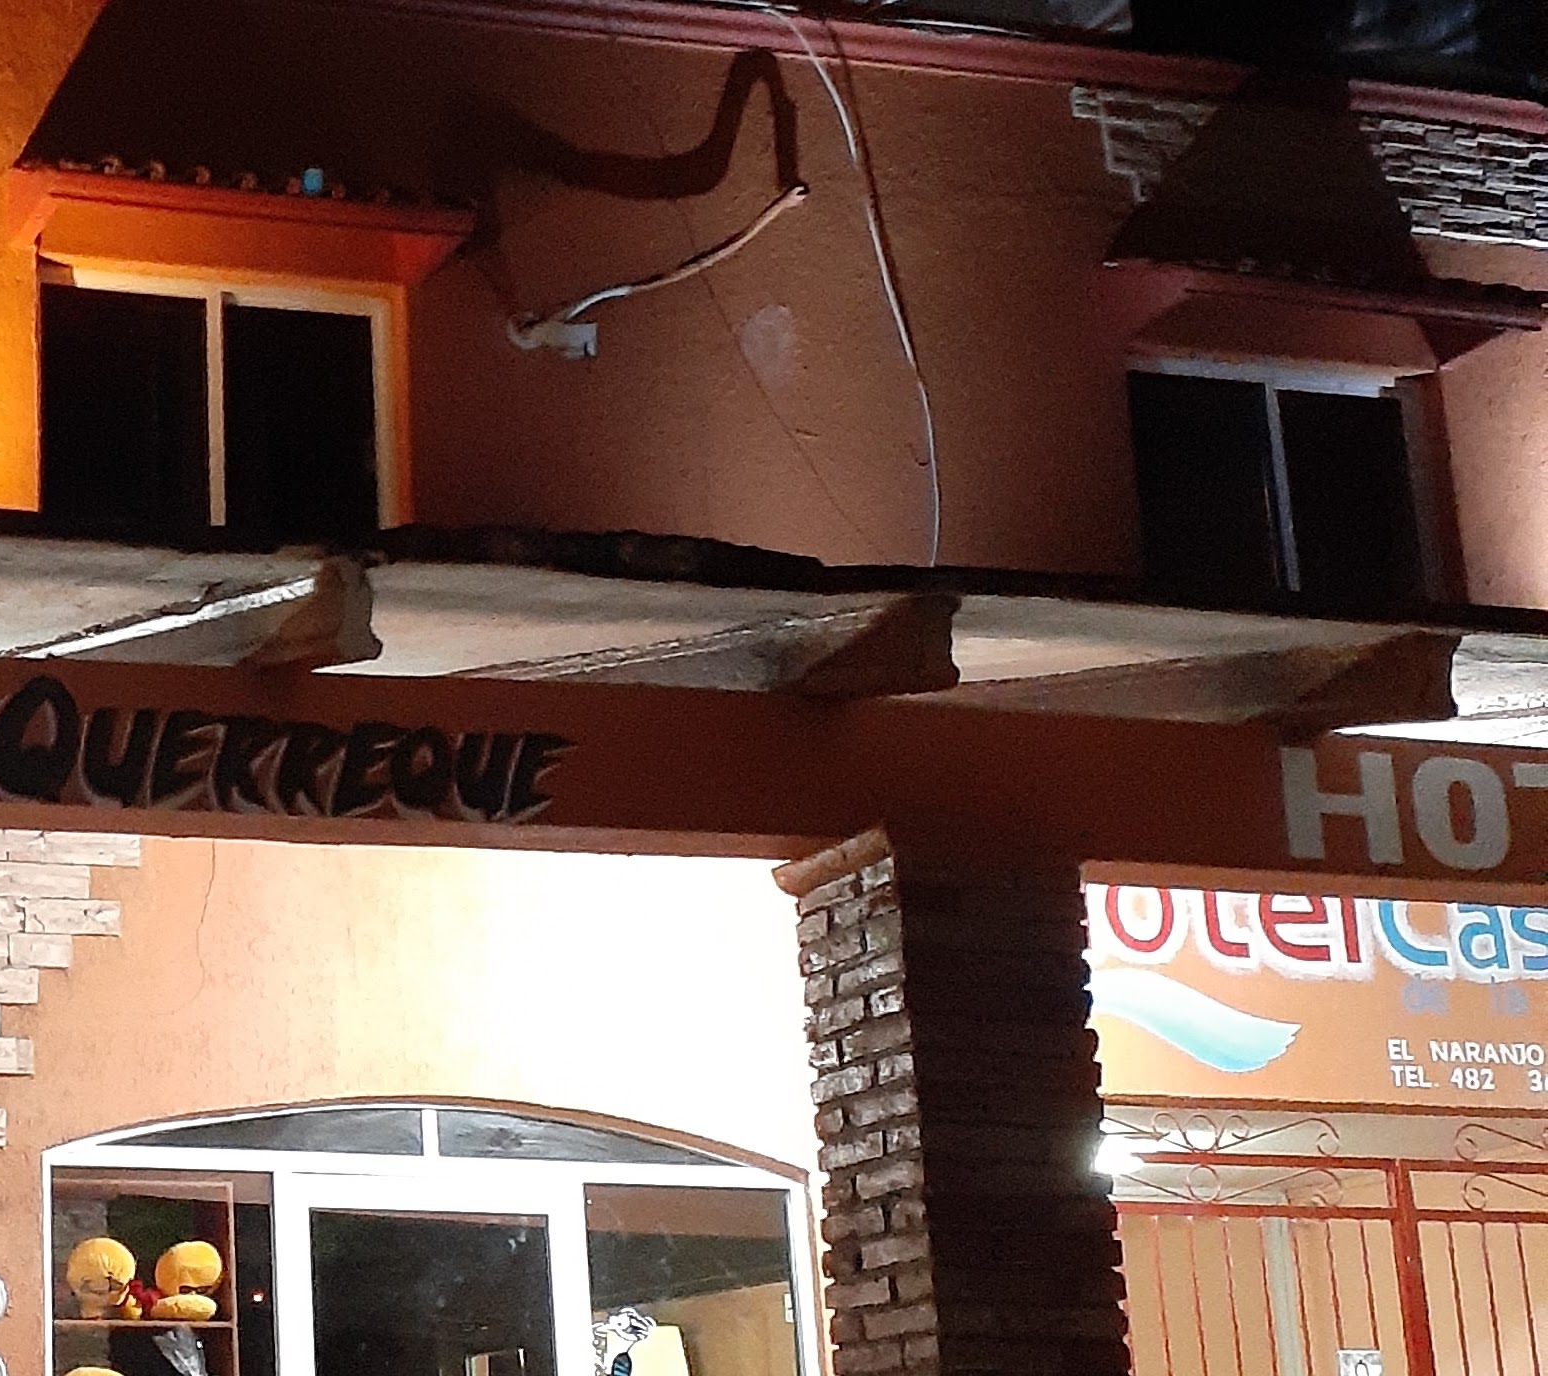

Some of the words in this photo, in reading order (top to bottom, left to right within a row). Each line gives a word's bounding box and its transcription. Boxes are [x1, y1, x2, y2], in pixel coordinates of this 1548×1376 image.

[1387, 1038, 1415, 1062] EL
[1428, 1040, 1545, 1066] NARANJO
[1390, 1064, 1440, 1089] TEL.
[1450, 1067, 1496, 1091] 482
